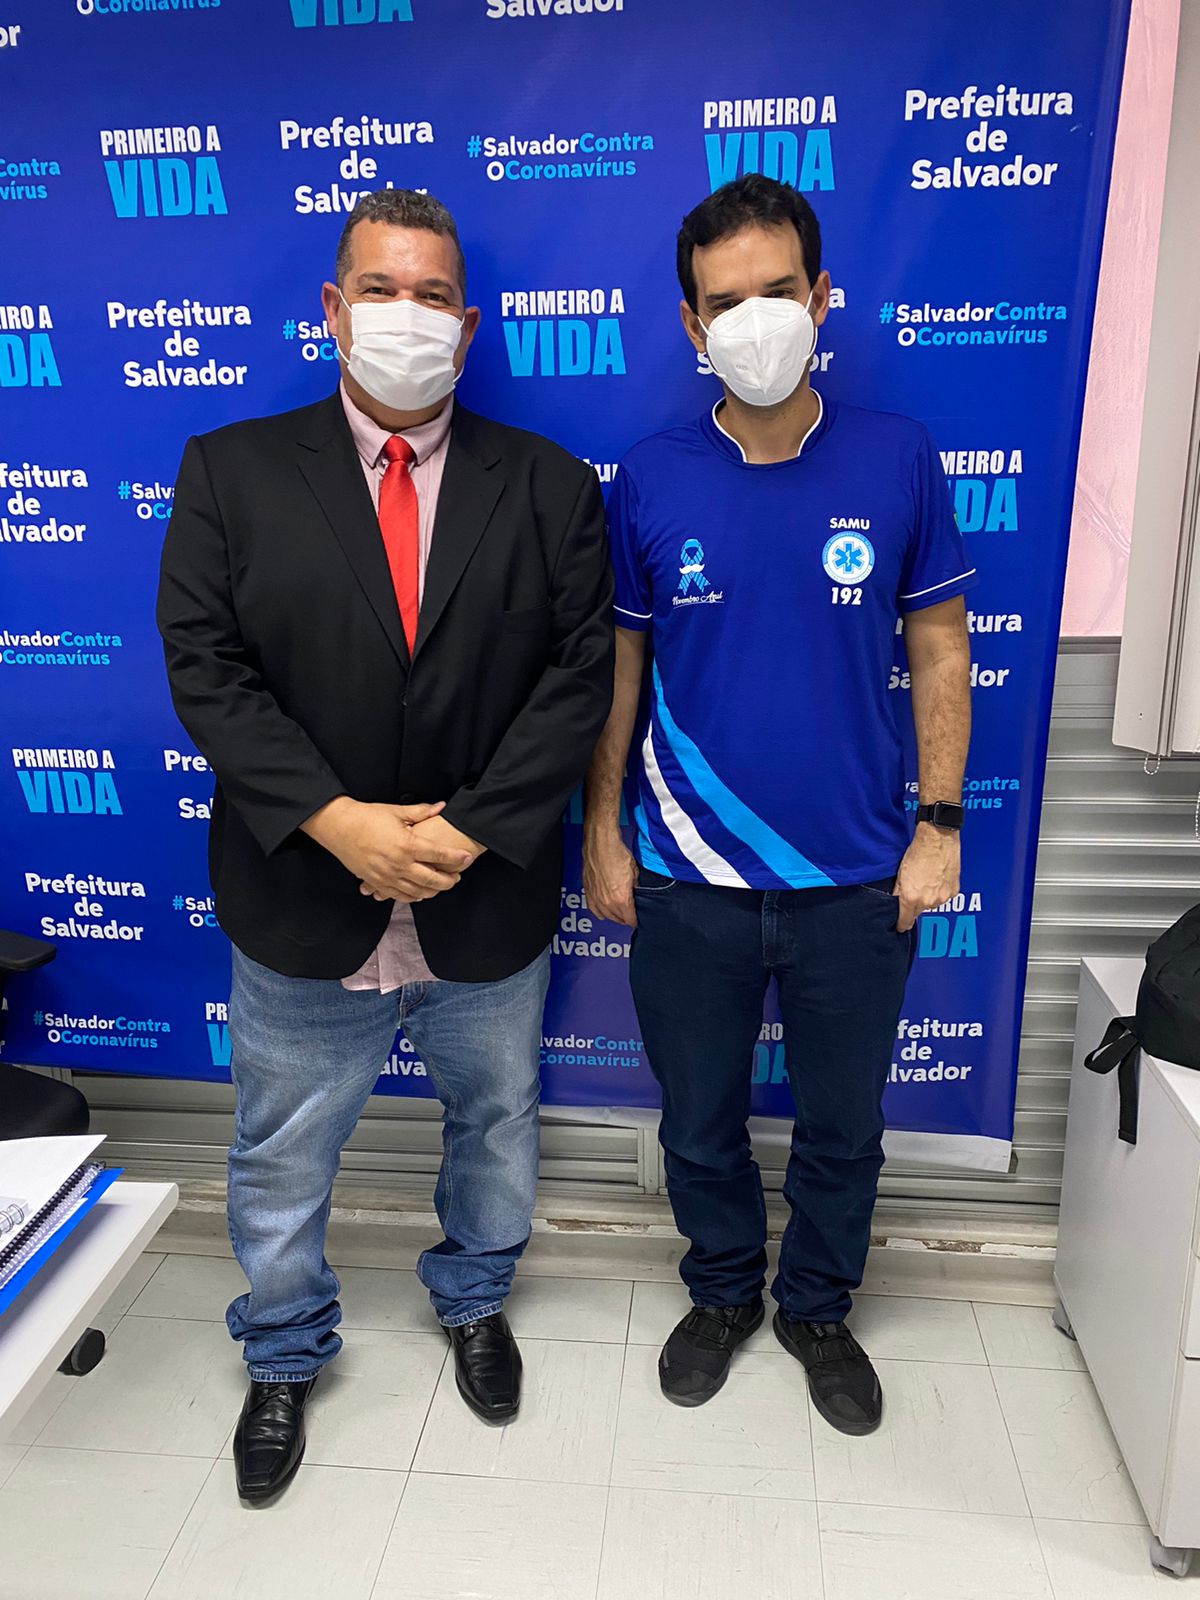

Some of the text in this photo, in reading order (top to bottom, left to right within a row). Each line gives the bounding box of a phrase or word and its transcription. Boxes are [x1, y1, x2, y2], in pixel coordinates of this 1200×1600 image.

[703, 95, 837, 129] PRIMEIRO A
[904, 83, 1073, 121] Prefeitura
[99, 125, 222, 156] PRIMEIRO A
[279, 115, 434, 150] Prefeitura
[467, 132, 654, 158] #SalvadorContra
[965, 120, 1008, 153] de
[339, 149, 378, 180] de
[486, 160, 637, 182] OCoronavírus
[704, 129, 835, 194] VIDA
[910, 154, 1059, 190] Salvador
[103, 156, 229, 219] VIDA
[106, 298, 252, 329] Prefeitura
[501, 288, 625, 317] PRIMEIRO A
[879, 301, 1067, 324] #SalvadorContra
[38, 304, 54, 329] A
[164, 329, 200, 358] de
[502, 317, 627, 377] VIDA
[897, 324, 1048, 347] OCoronavírus
[0, 332, 63, 388] DA
[123, 358, 248, 388] Salvador
[939, 449, 1023, 475] MEIRO A
[0, 462, 89, 489] feitura
[7, 490, 41, 516] de
[947, 478, 1018, 533] DA
[0, 517, 87, 543] lvador
[829, 517, 870, 531] SAMU
[831, 586, 863, 606] 192
[0, 630, 123, 647] lvadorContra
[0, 648, 111, 666] Coronavírus
[11, 748, 116, 769] PRIMEIRO A
[16, 770, 124, 816] VIDA
[24, 872, 146, 898] Prefeitura
[73, 896, 104, 918] de
[968, 892, 982, 912] A
[40, 916, 144, 941] Salvador
[560, 910, 593, 934] de
[550, 934, 631, 958] lvador
[918, 914, 979, 959] DA
[33, 1010, 171, 1033] #SalvadorContra
[897, 1017, 983, 1040] feitura
[47, 1029, 158, 1049] OCoronavírus
[900, 1040, 933, 1061] de
[380, 1054, 427, 1076] alva
[540, 1050, 640, 1067] Coronavírus
[886, 1060, 973, 1084] lvador
